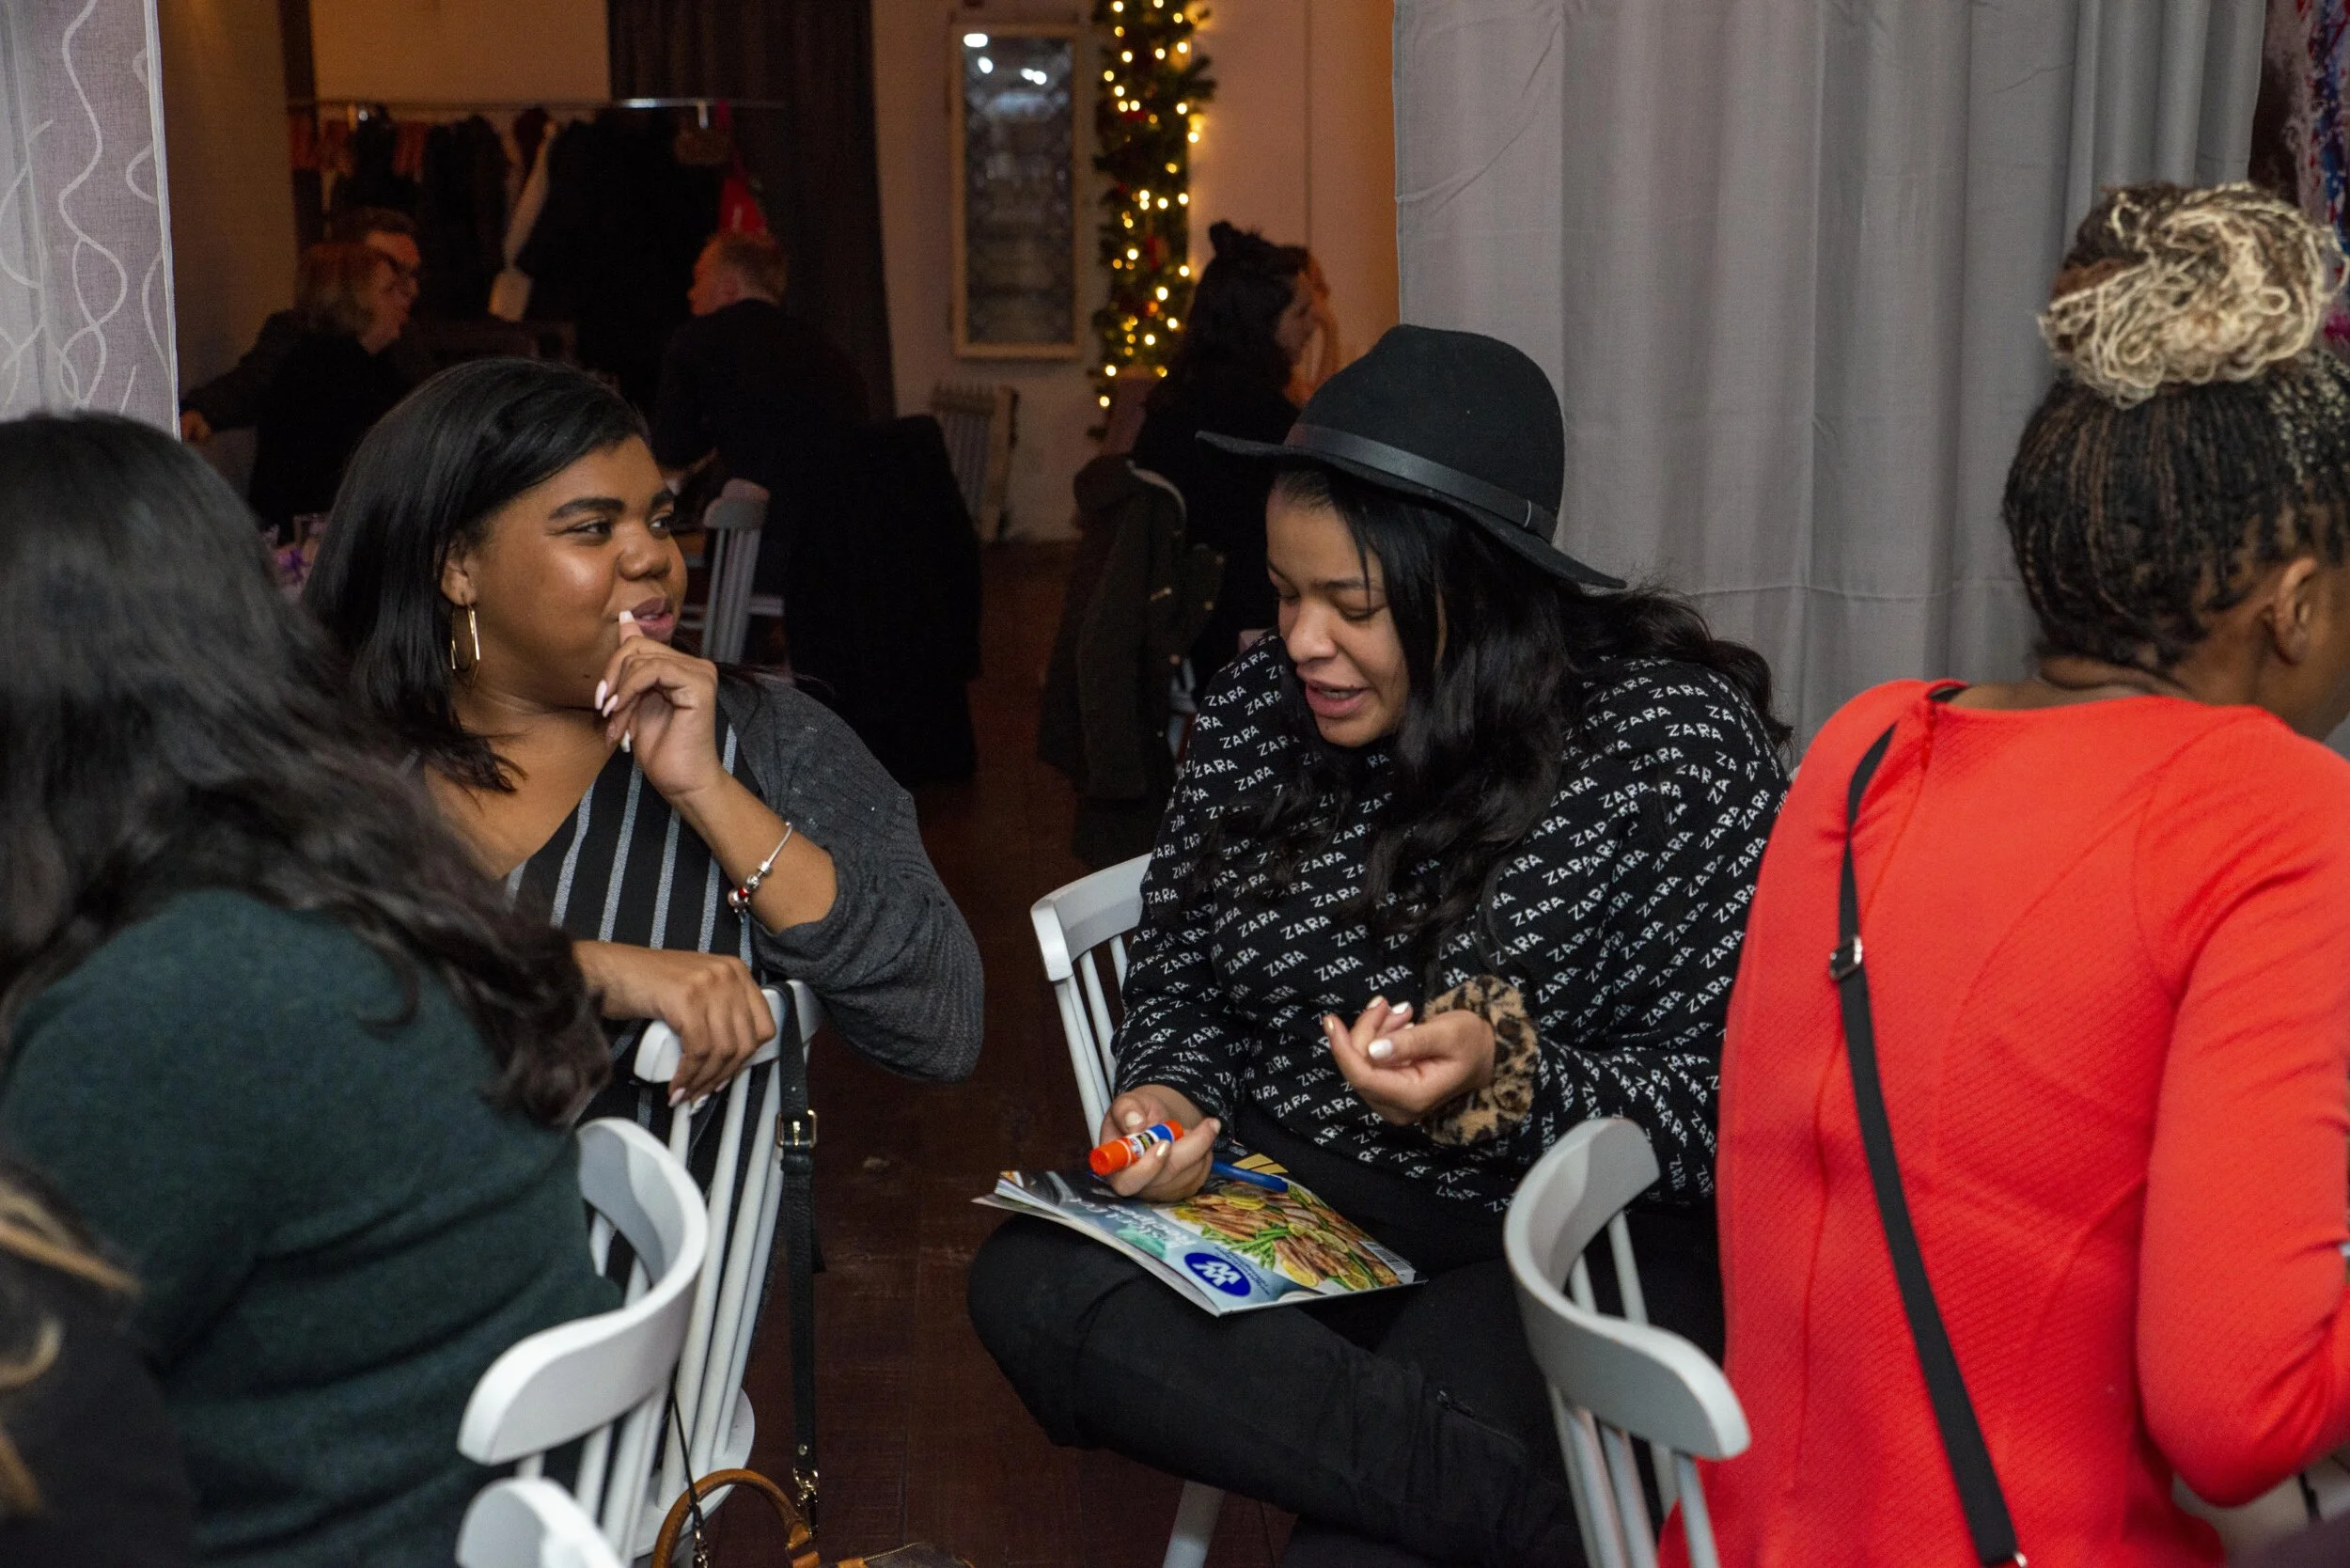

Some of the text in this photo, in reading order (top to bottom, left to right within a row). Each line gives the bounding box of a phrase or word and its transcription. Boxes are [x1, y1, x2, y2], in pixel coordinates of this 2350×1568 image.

[1231, 651, 1270, 679] ZARA
[1205, 686, 1246, 707] ZARA
[1600, 677, 1653, 702] ZARA
[1649, 684, 1709, 699] ZARA
[1245, 691, 1281, 716] ZARA
[1705, 704, 1736, 724] ZA
[1193, 713, 1224, 731] RA
[1613, 706, 1671, 733] ZARA
[1219, 725, 1260, 749] ZARA
[1665, 723, 1724, 742] ZARA
[1194, 760, 1238, 779] ZARA
[1368, 754, 1389, 768] RA
[1629, 747, 1684, 772] ZARA
[1716, 750, 1738, 772] ZA
[1234, 766, 1275, 792] ZARA
[1675, 764, 1712, 784] ZAR
[1550, 776, 1598, 808] ZARA
[1598, 781, 1649, 808] ZARA
[1660, 781, 1682, 799] RA
[1706, 779, 1731, 805] ZA
[1738, 790, 1770, 831] ZARA
[1332, 823, 1371, 844] ZAR
[1569, 821, 1606, 848] ZAR
[1700, 807, 1741, 850] ZARA
[1297, 852, 1347, 873] ZARA
[1652, 832, 1695, 872] ZARA
[1726, 838, 1767, 878] ZARA
[1342, 864, 1366, 879] ZA
[1501, 854, 1543, 880] ARA
[1542, 856, 1590, 886] ZARA
[1146, 887, 1179, 904] ZARA
[1310, 886, 1362, 908] ZARA
[1567, 884, 1608, 921] ZARA
[1636, 877, 1683, 917] ZARA
[1712, 885, 1756, 924] ZARA
[1214, 906, 1242, 934] ZARA
[1237, 910, 1280, 938] ZARA
[1509, 897, 1565, 927] ZARA
[1663, 902, 1709, 946] ZARA
[1132, 927, 1158, 945] ARA
[1279, 917, 1331, 940] ZARA
[1331, 925, 1366, 948] ZAR
[1621, 921, 1664, 961] ZARA
[1384, 933, 1409, 950] ZA
[1489, 933, 1544, 965] ZARA
[1546, 928, 1595, 963] ZARA
[1700, 931, 1746, 969] ZARA
[1160, 951, 1206, 975] ZARA
[1225, 948, 1261, 975] ZARA
[1262, 950, 1308, 978] ZARA
[1313, 955, 1364, 982] ZARA
[1649, 948, 1696, 988] ZARA
[1365, 964, 1413, 991] ZARA
[1445, 967, 1470, 987] RA
[1536, 968, 1581, 1004] ZARA
[1197, 987, 1222, 1002] ZA
[1685, 976, 1732, 1014] ZARA
[1268, 1005, 1302, 1028] ARA
[1540, 1011, 1569, 1028] RA
[1641, 991, 1685, 1027] ZARA
[1182, 1026, 1224, 1047] ZARA
[1225, 1038, 1251, 1056] ZAR
[1274, 1093, 1311, 1119] ZARA
[1311, 1097, 1358, 1120] ZARA
[1358, 1112, 1383, 1126] ZA
[1313, 1124, 1347, 1146] ARA
[1358, 1146, 1386, 1163] RA
